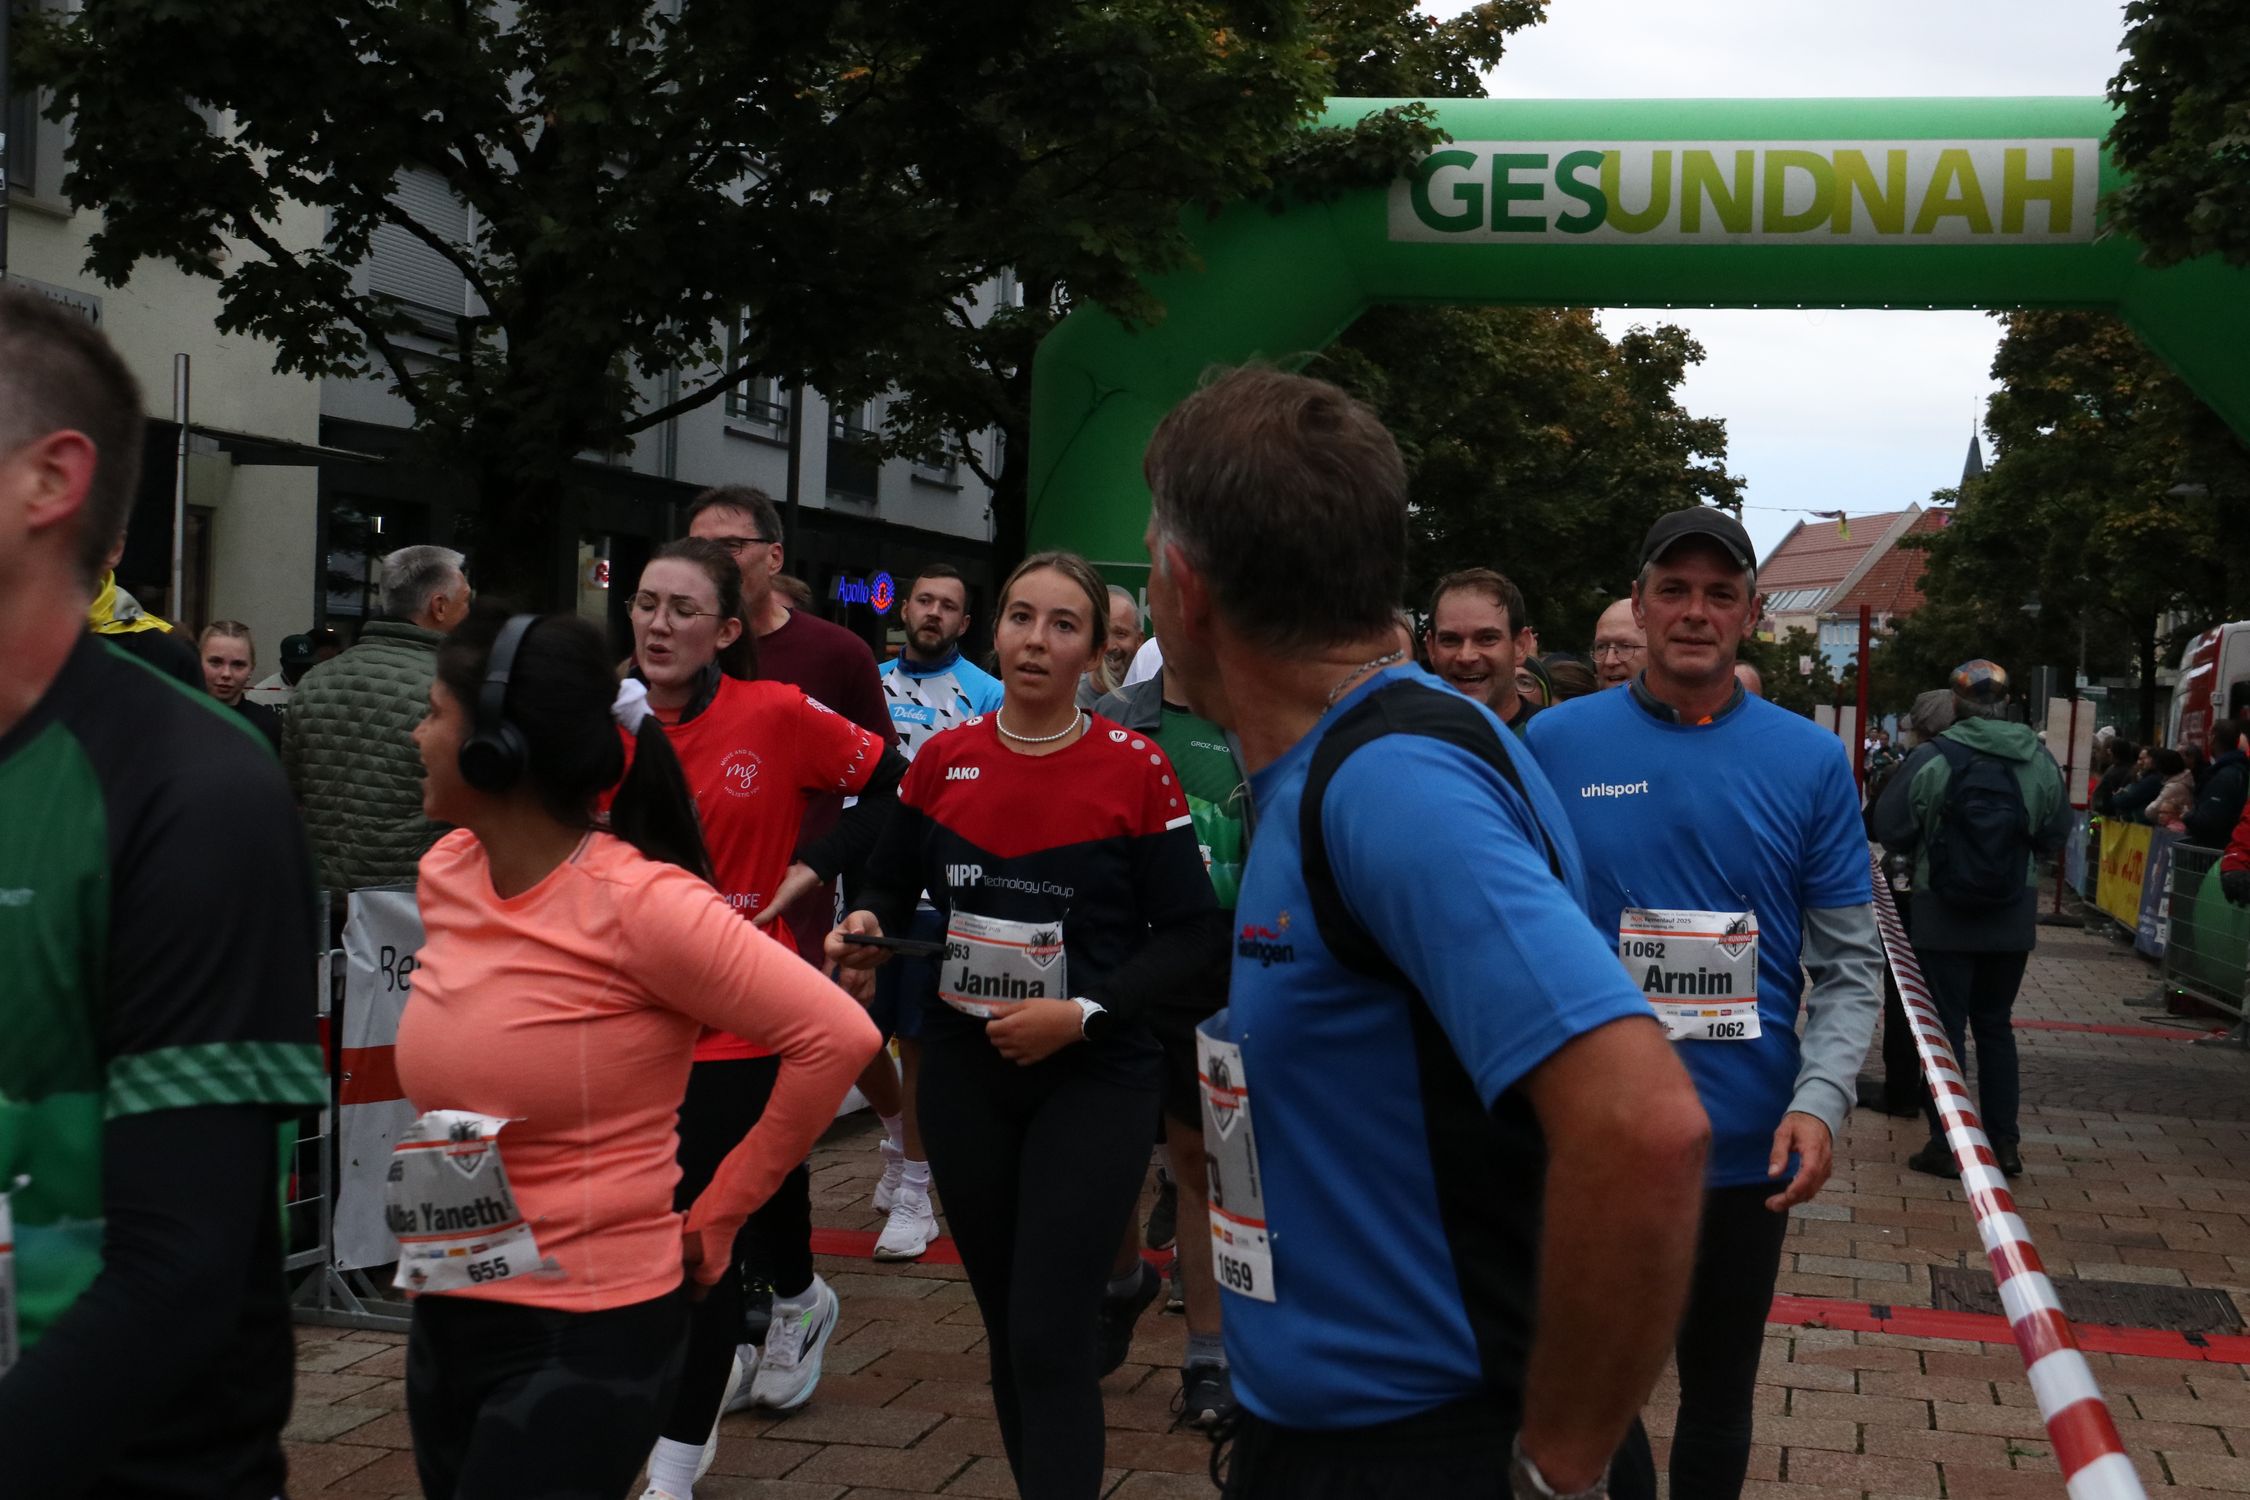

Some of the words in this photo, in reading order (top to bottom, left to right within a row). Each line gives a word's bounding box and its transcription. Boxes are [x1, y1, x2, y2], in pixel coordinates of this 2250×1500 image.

[1410, 147, 2075, 235] GESUNDNAH
[838, 576, 869, 608] Apollo
[893, 706, 928, 721] Debeka
[945, 766, 980, 780] JAKO
[1581, 780, 1649, 798] uhlsport
[945, 863, 983, 888] HIPP
[982, 875, 1040, 894] Technology
[1042, 880, 1075, 897] Group
[1623, 941, 1666, 959] 1062
[381, 945, 422, 992] Be
[954, 966, 1045, 998] Janina
[1643, 965, 1732, 995] Arnim
[1707, 1021, 1745, 1037] 1062
[420, 1196, 508, 1231] Yaneth
[466, 1256, 511, 1283] 655
[1218, 1252, 1253, 1292] 1659
